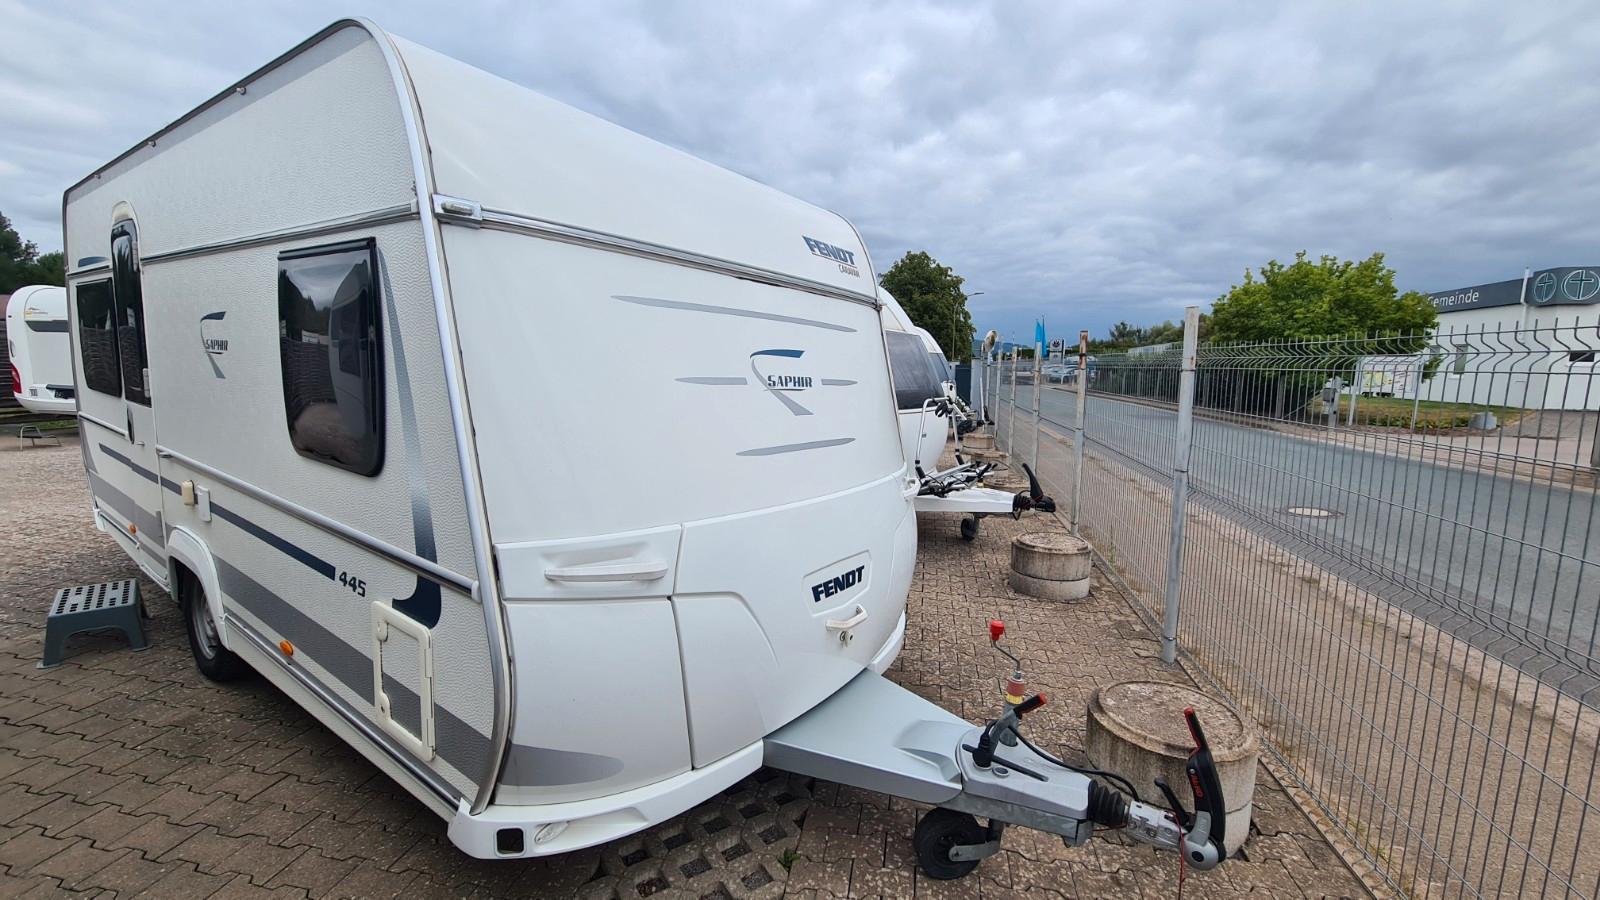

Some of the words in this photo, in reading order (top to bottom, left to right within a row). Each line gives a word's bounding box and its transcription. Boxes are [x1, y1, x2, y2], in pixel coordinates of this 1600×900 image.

[802, 235, 855, 266] FENDT
[205, 339, 229, 352] SAPHIR
[767, 374, 813, 388] SAPHIR
[339, 571, 367, 598] 445
[811, 564, 865, 603] FENDT
